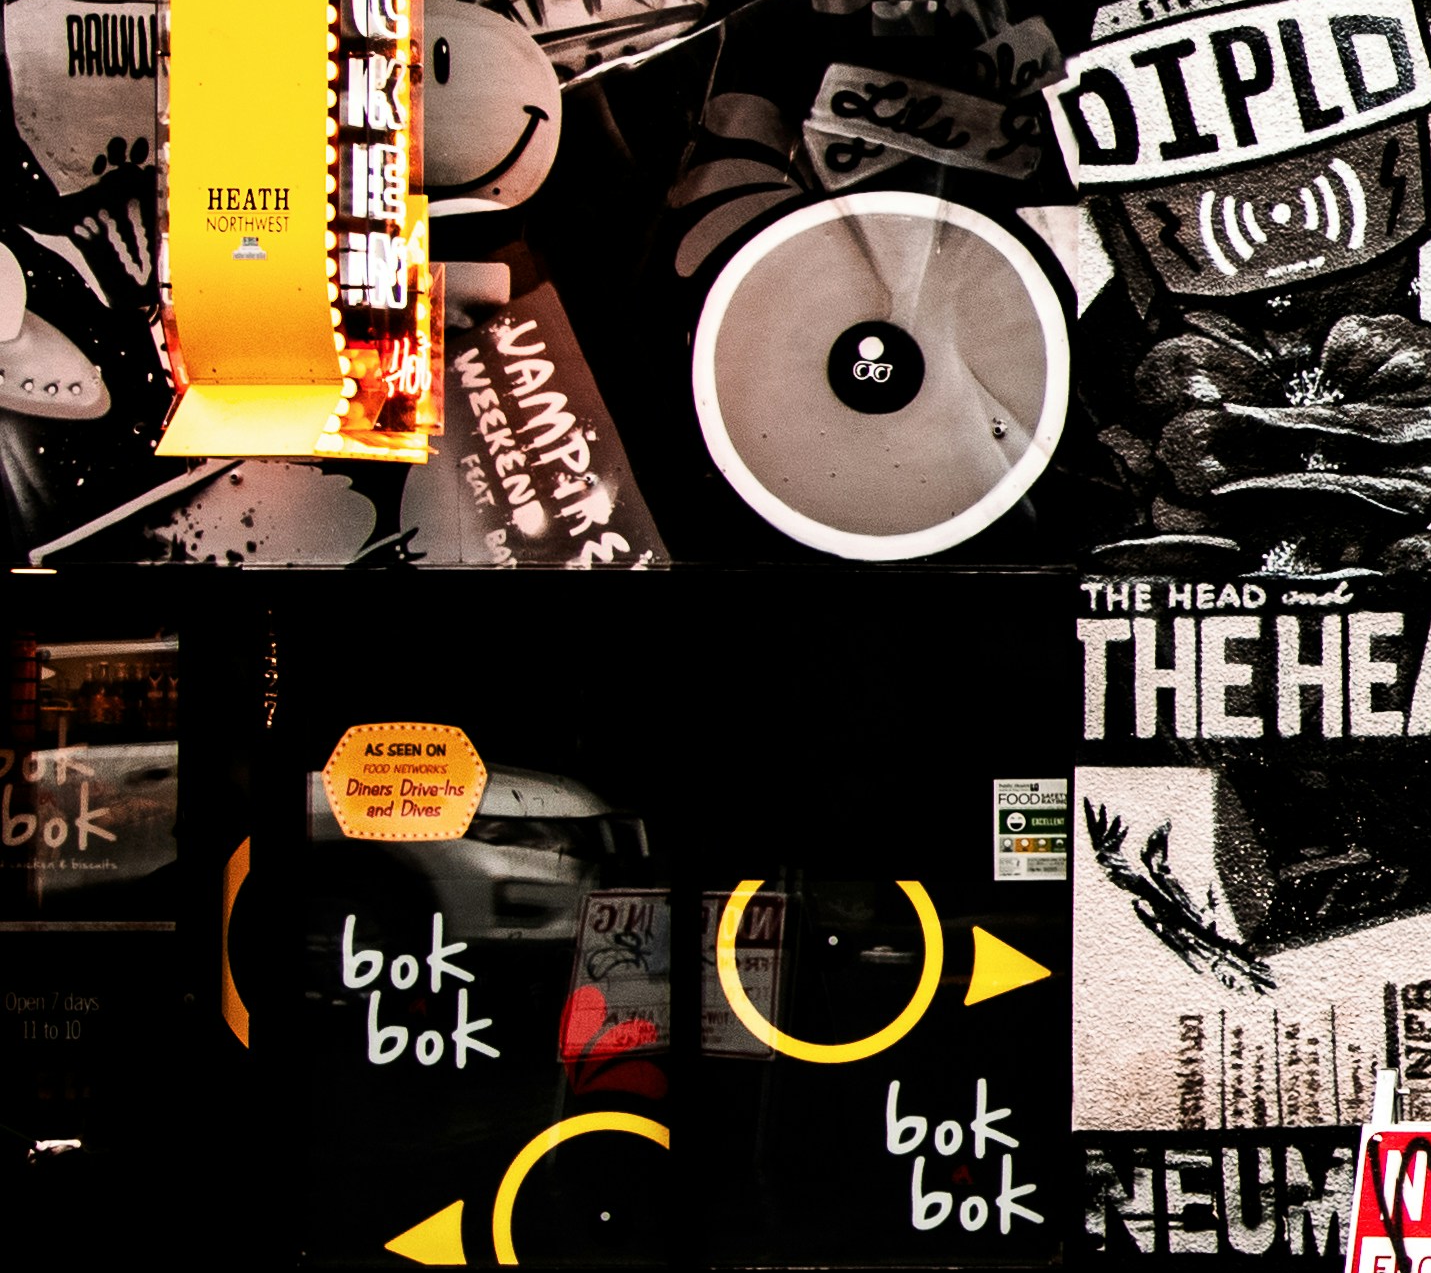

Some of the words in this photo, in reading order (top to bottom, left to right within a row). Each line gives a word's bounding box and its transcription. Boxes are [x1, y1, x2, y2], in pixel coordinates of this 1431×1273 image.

[207, 187, 291, 211] HEATH
[206, 215, 291, 233] NORTHWEST
[453, 346, 548, 537] WEEKEND
[1080, 581, 1152, 612] THE
[1167, 581, 1267, 610] HEAD
[1281, 579, 1354, 607] and
[1077, 616, 1264, 740] THE
[364, 742, 385, 757] AS
[386, 742, 422, 757] SEEN
[425, 742, 447, 757] ON
[362, 763, 391, 775] FOOD
[345, 777, 394, 797] Diners
[399, 777, 466, 797] Drive-Ins
[366, 800, 395, 819] and
[400, 799, 442, 818] Dives
[998, 792, 1041, 806] FOOD
[0, 781, 118, 852] bok
[1031, 817, 1065, 826] EXCELLENT
[341, 912, 475, 994] bok
[5, 991, 46, 1014] Open
[64, 991, 100, 1014] days
[44, 1021, 58, 1040] to
[65, 1020, 82, 1040] 10
[367, 989, 500, 1070] bok
[885, 1078, 1020, 1159] bok
[910, 1153, 1044, 1236] bok
